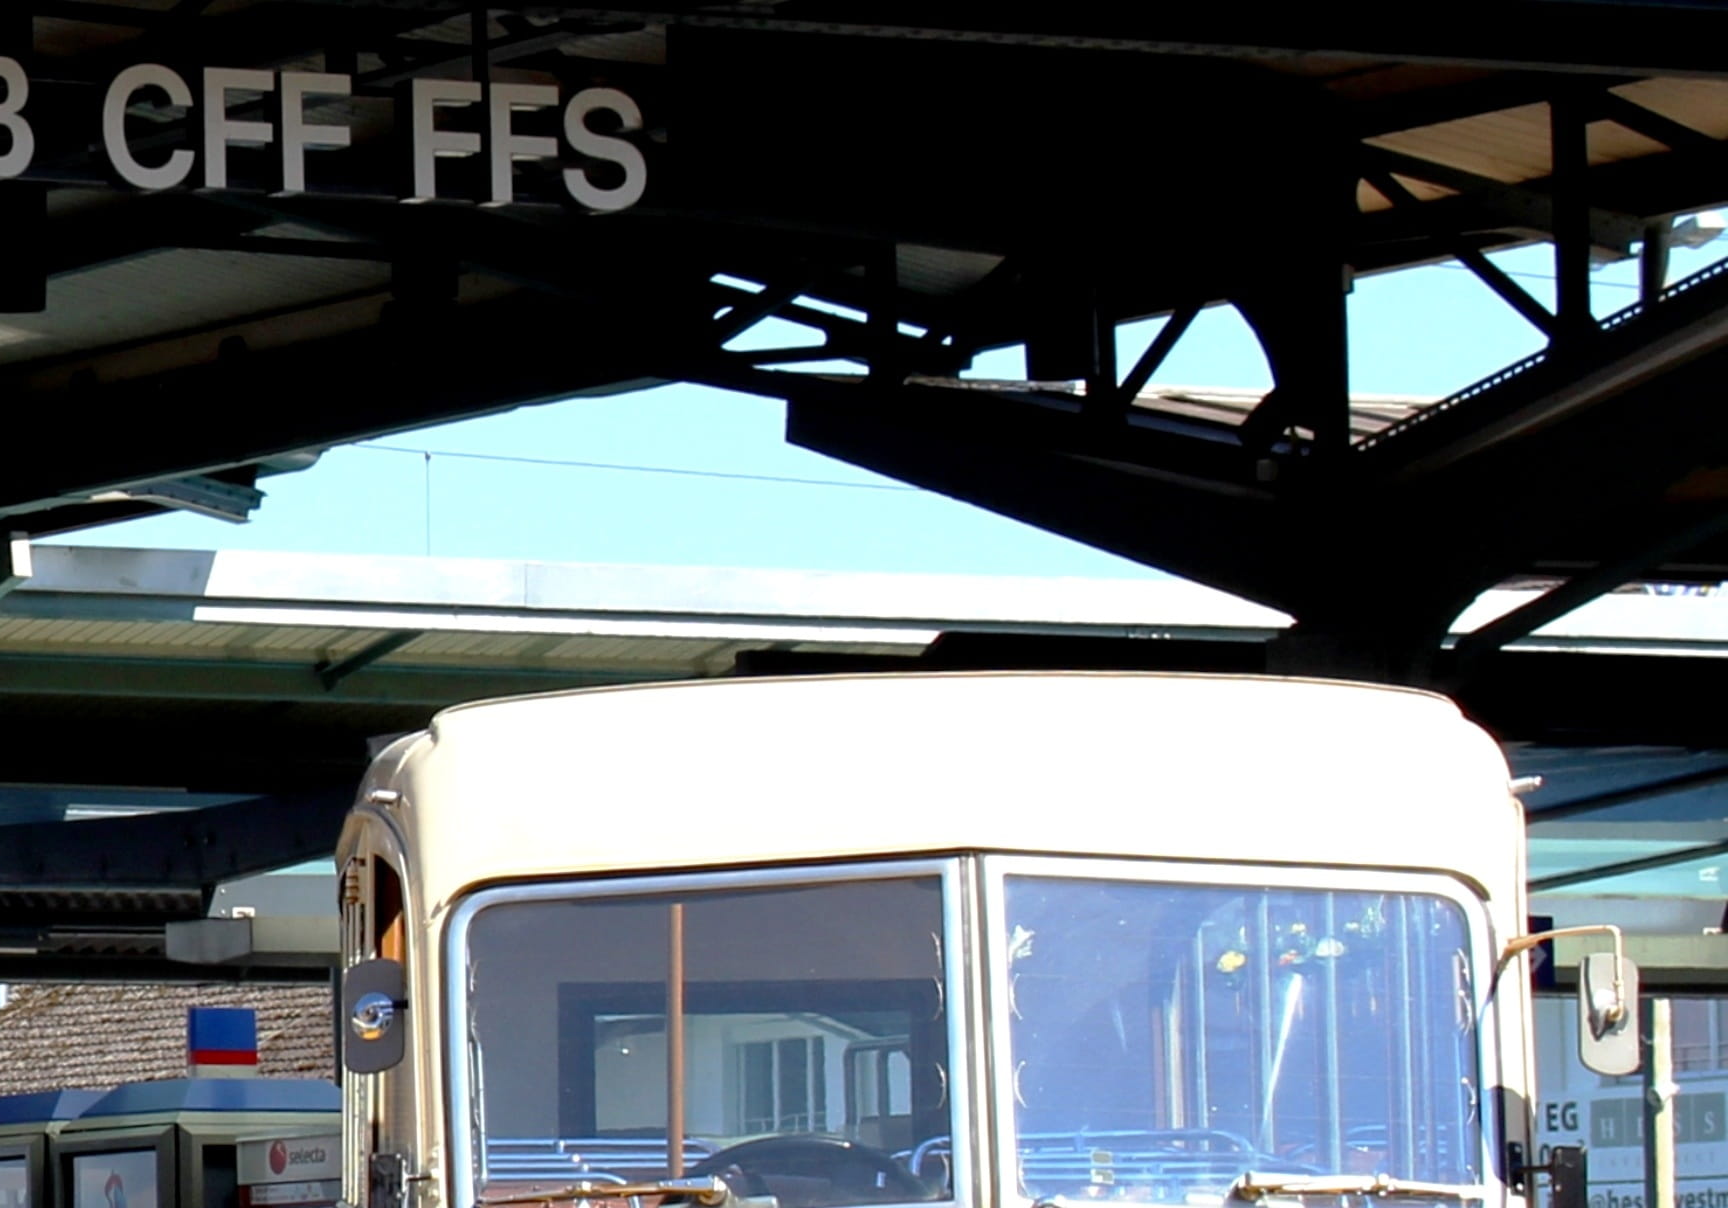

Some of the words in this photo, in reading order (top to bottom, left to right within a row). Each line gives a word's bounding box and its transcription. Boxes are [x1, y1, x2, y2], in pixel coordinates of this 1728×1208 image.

[102, 64, 352, 191] CFF
[412, 78, 647, 210] FFS
[1546, 1101, 1578, 1132] EG
[288, 1148, 327, 1164] selecta
